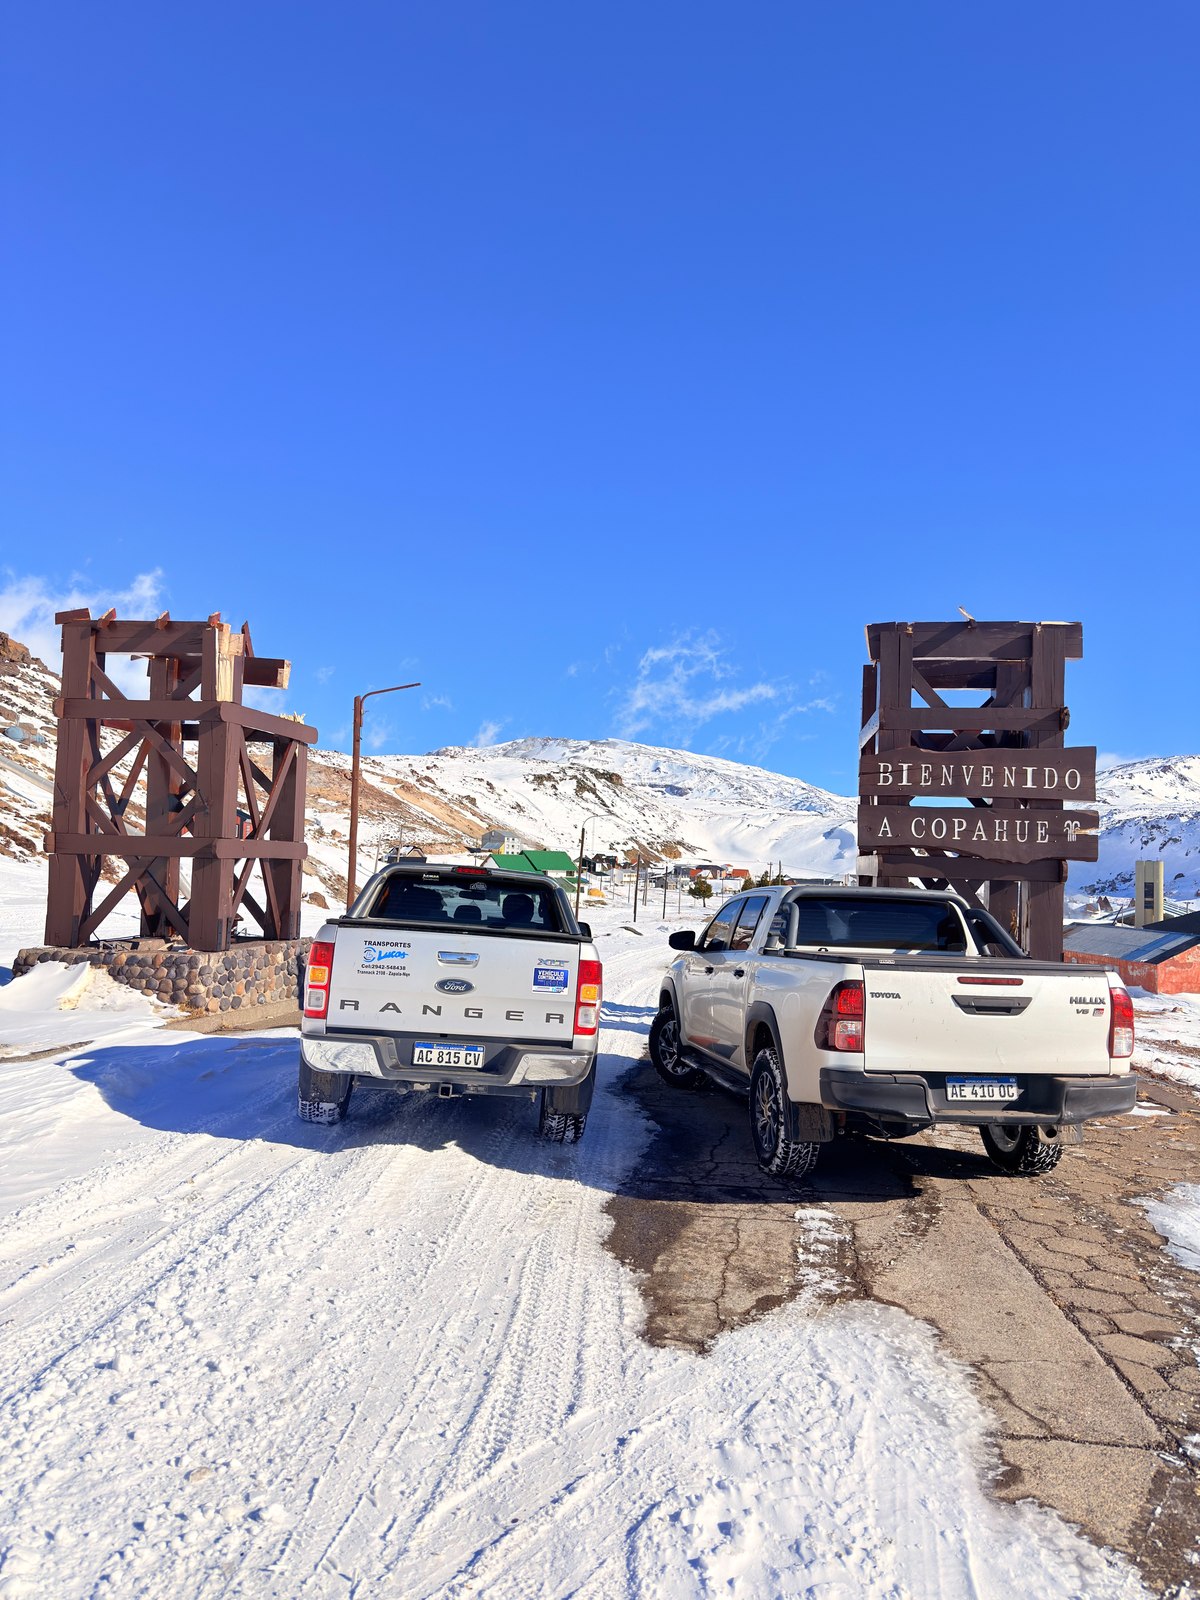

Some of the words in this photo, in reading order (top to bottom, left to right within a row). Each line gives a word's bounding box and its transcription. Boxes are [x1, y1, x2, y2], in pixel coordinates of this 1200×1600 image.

[877, 762, 1081, 790] BIENVENIDO
[878, 816, 893, 838] A
[910, 816, 1049, 843] COPAHUE
[363, 940, 412, 949] TRANSPORTES
[377, 950, 409, 962] Lucas
[444, 980, 467, 992] Ford
[869, 991, 902, 1000] TOYOTA
[1069, 996, 1107, 1006] HILUX
[339, 999, 565, 1024] RANGER
[416, 1049, 433, 1063] AC
[436, 1050, 461, 1065] 815
[464, 1052, 481, 1066] CV
[951, 1084, 967, 1098] AE
[971, 1084, 995, 1098] 410
[998, 1084, 1015, 1098] OC
